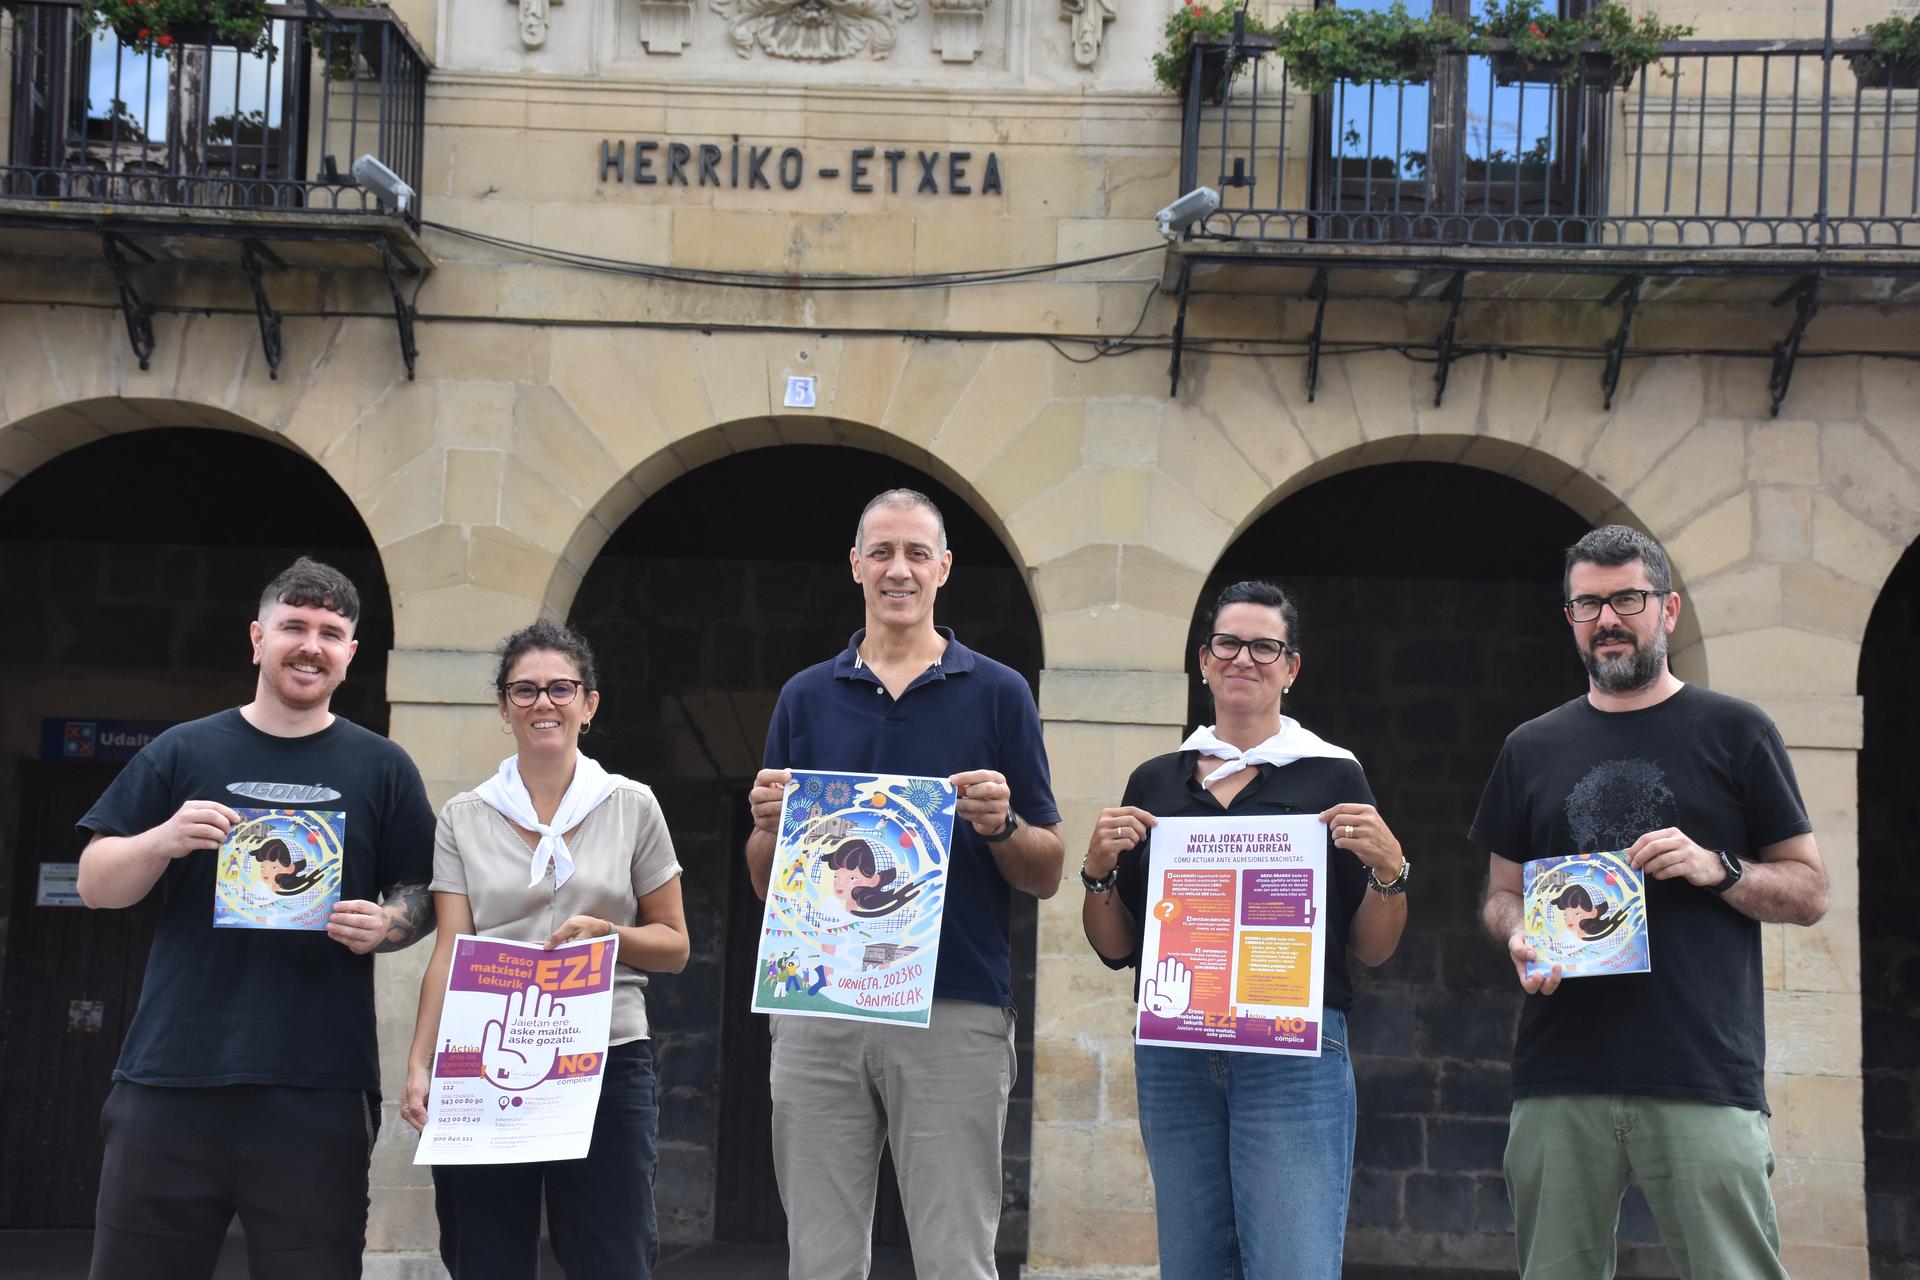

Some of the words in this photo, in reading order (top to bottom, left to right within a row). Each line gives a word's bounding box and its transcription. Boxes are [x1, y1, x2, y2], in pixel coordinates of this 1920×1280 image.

[795, 382, 805, 401] 5
[1190, 833, 1216, 843] NOLA
[1218, 833, 1255, 843] JOKATU
[1257, 832, 1289, 842] ERASO
[1186, 844, 1243, 853] MATXISTEN
[1245, 843, 1292, 853] AURREAN
[498, 953, 534, 967] Eraso
[535, 941, 605, 991] EZ!
[470, 963, 533, 979] matxistei
[884, 963, 922, 989] 2023KO
[478, 974, 524, 990] lekurik
[511, 1018, 550, 1027] Jaietan
[552, 1018, 570, 1027] ere
[1204, 1006, 1237, 1028] EZ!
[1275, 1016, 1306, 1033] NO
[510, 1027, 536, 1036] aske
[508, 1036, 534, 1044] aske
[558, 1053, 598, 1075] NO
